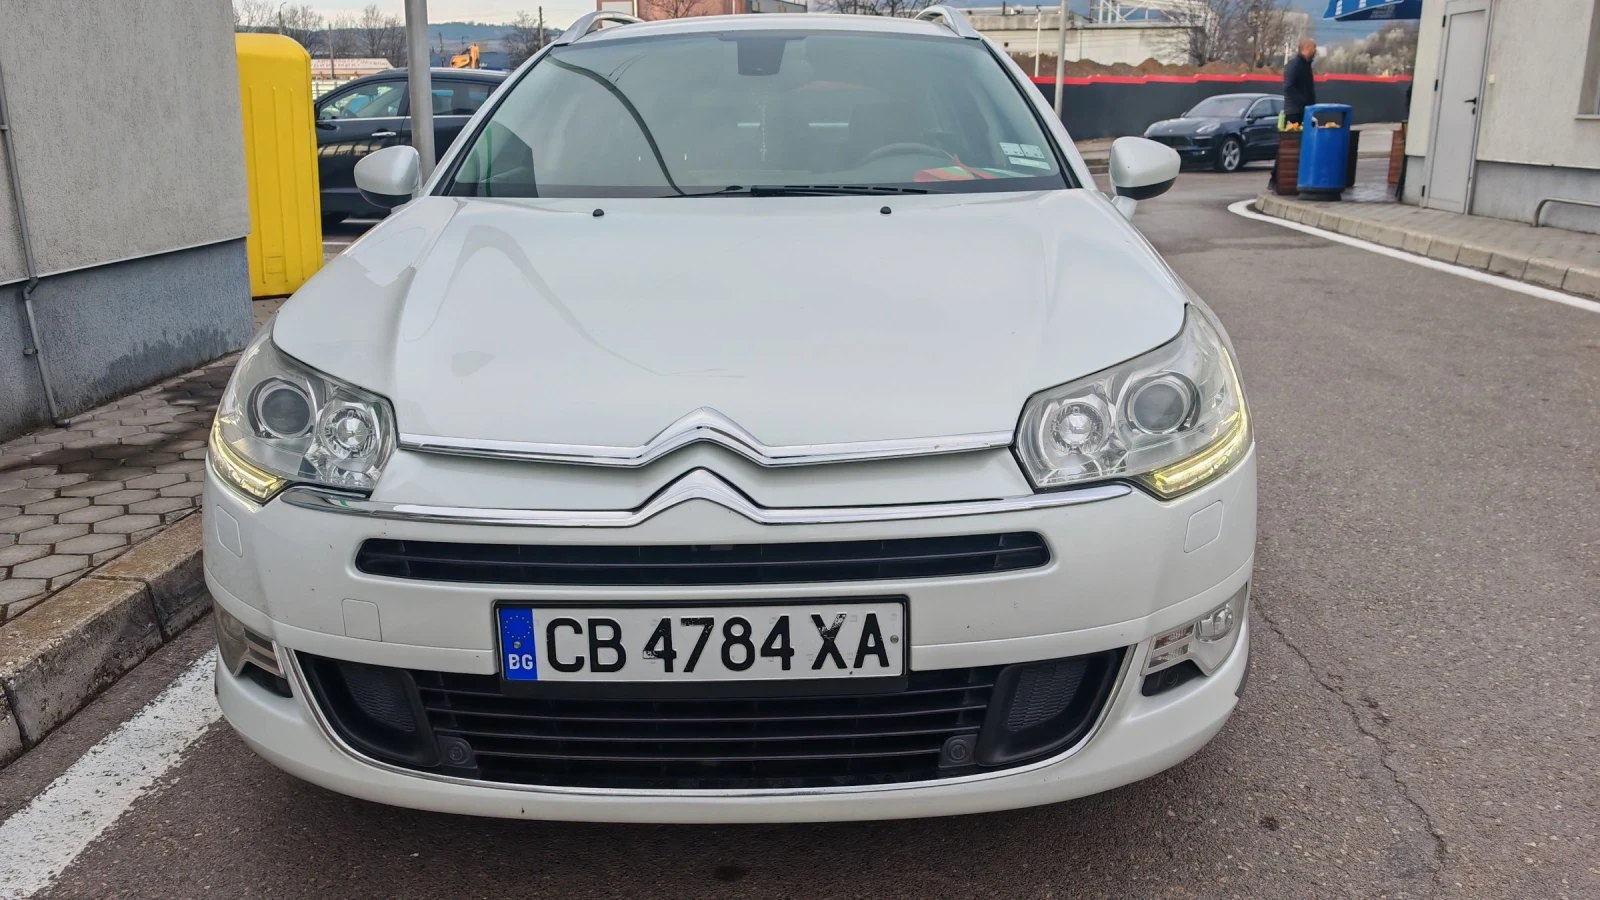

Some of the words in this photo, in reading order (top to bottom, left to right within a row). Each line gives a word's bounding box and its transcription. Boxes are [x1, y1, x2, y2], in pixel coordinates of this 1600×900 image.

[508, 653, 533, 670] BG
[546, 617, 627, 673] CB
[642, 615, 795, 673] 4784
[811, 613, 890, 670] XA
